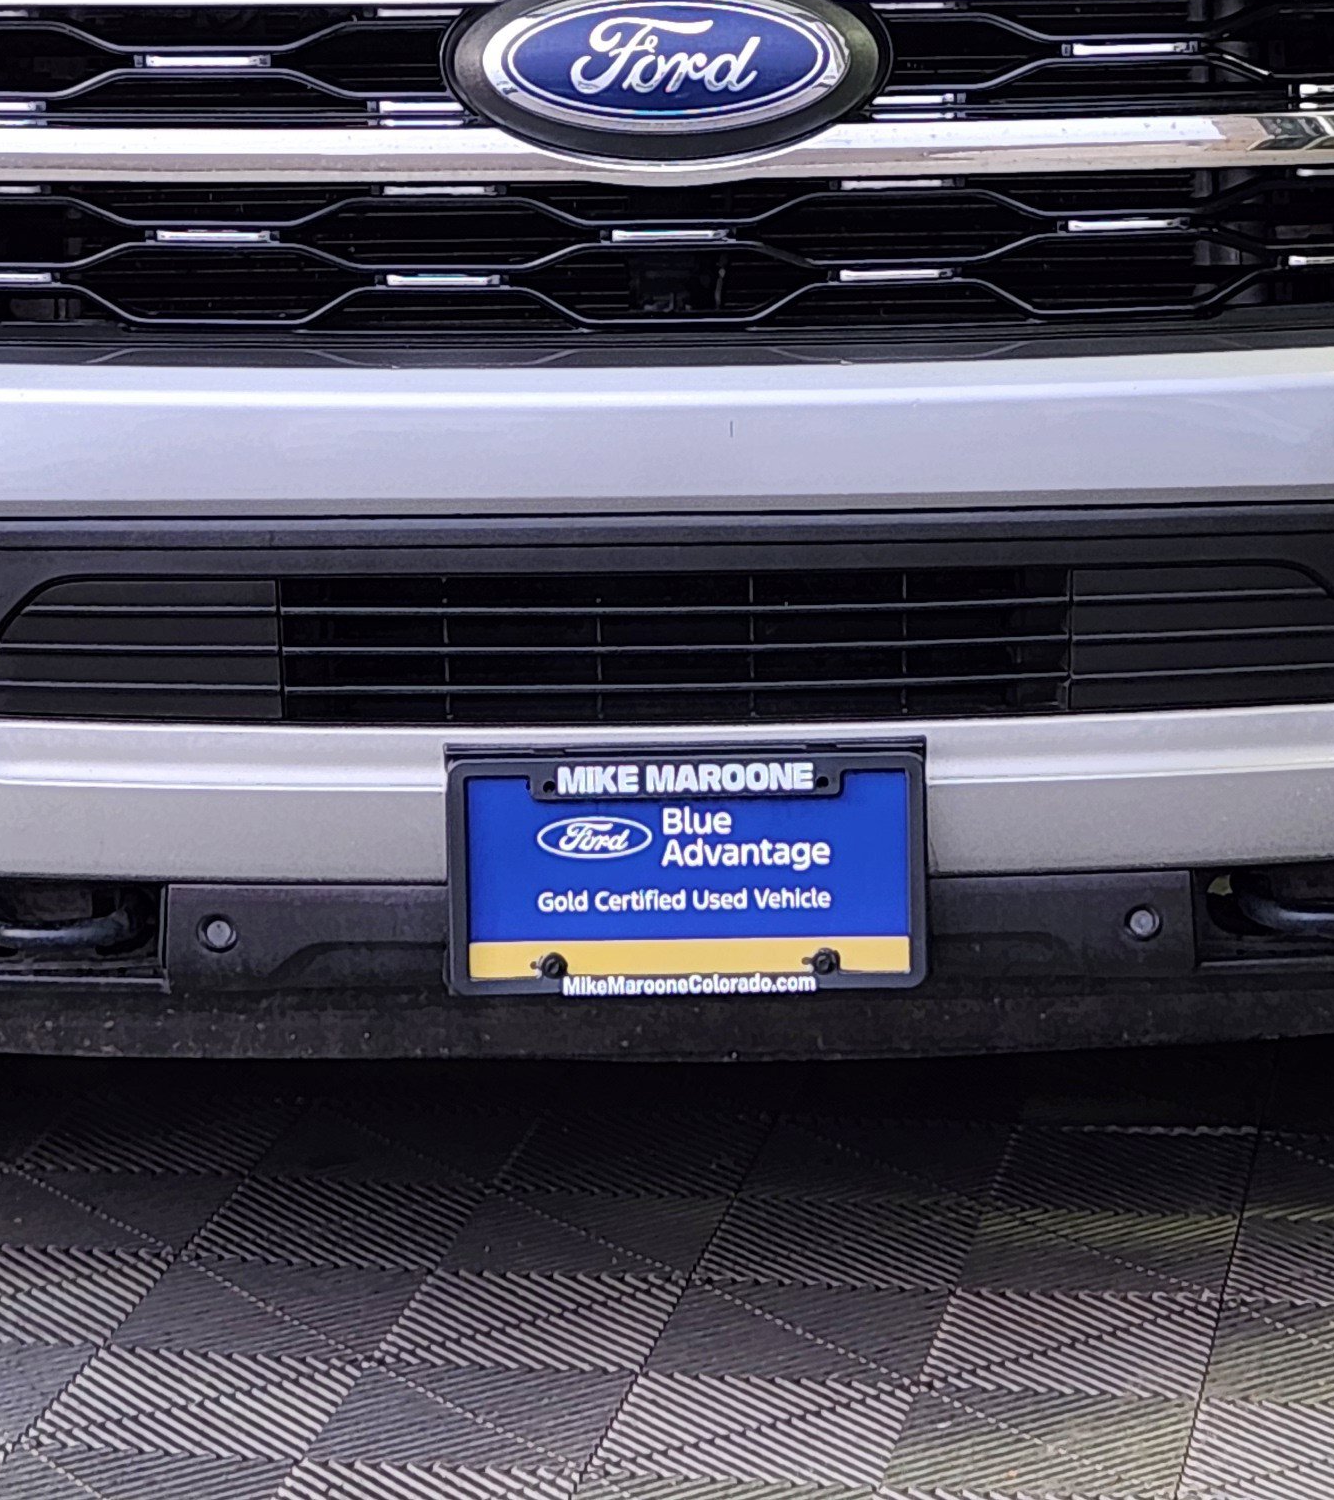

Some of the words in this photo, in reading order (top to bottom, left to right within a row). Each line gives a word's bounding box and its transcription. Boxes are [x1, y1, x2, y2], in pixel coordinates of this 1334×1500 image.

[570, 16, 762, 95] Ford
[556, 764, 640, 795] MIKE
[645, 761, 814, 794] MAROONE
[558, 821, 631, 852] Ford
[662, 806, 733, 836] Blue
[660, 837, 832, 872] Advantage
[537, 890, 589, 913] Gold
[593, 888, 687, 912] Certified
[692, 887, 748, 911] Used
[753, 886, 832, 910] Vehicle
[562, 973, 817, 996] MikeMarooneColorado.com
